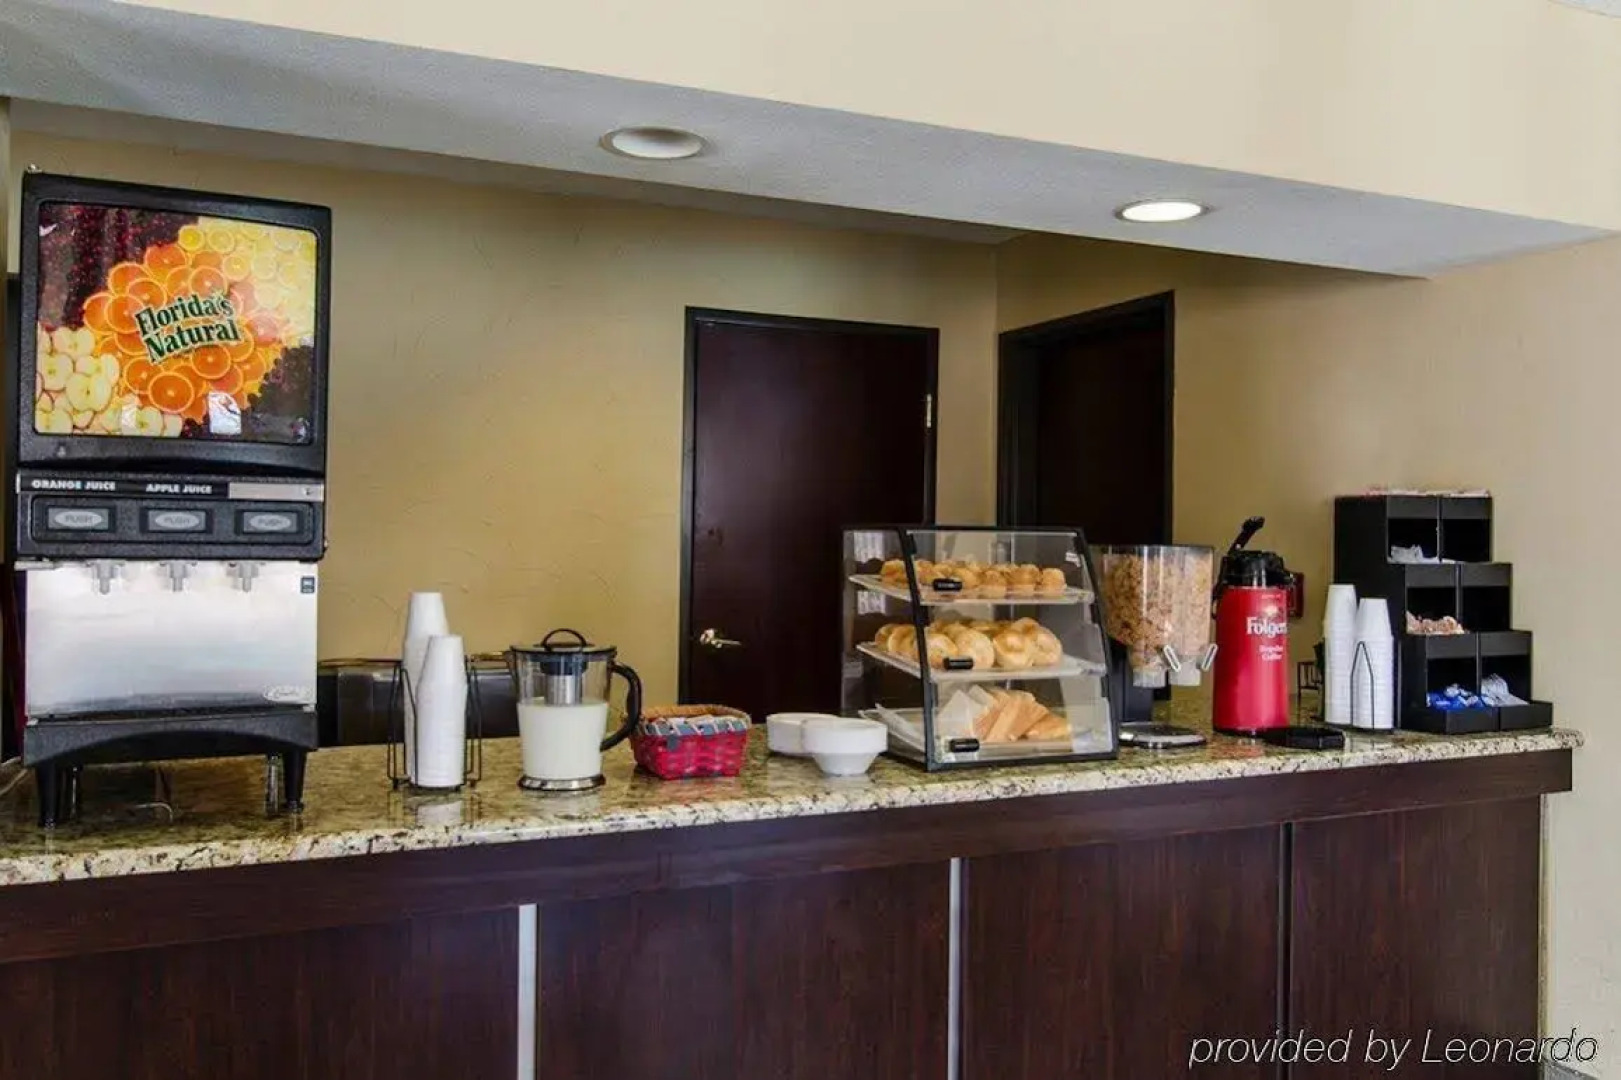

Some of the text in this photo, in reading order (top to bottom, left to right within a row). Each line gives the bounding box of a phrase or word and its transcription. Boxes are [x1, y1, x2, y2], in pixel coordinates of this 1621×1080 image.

[134, 293, 235, 337] Florida's
[143, 318, 242, 362] Natural
[31, 479, 116, 491] ORANGE JUICE
[146, 483, 213, 494] APPLE JUICE
